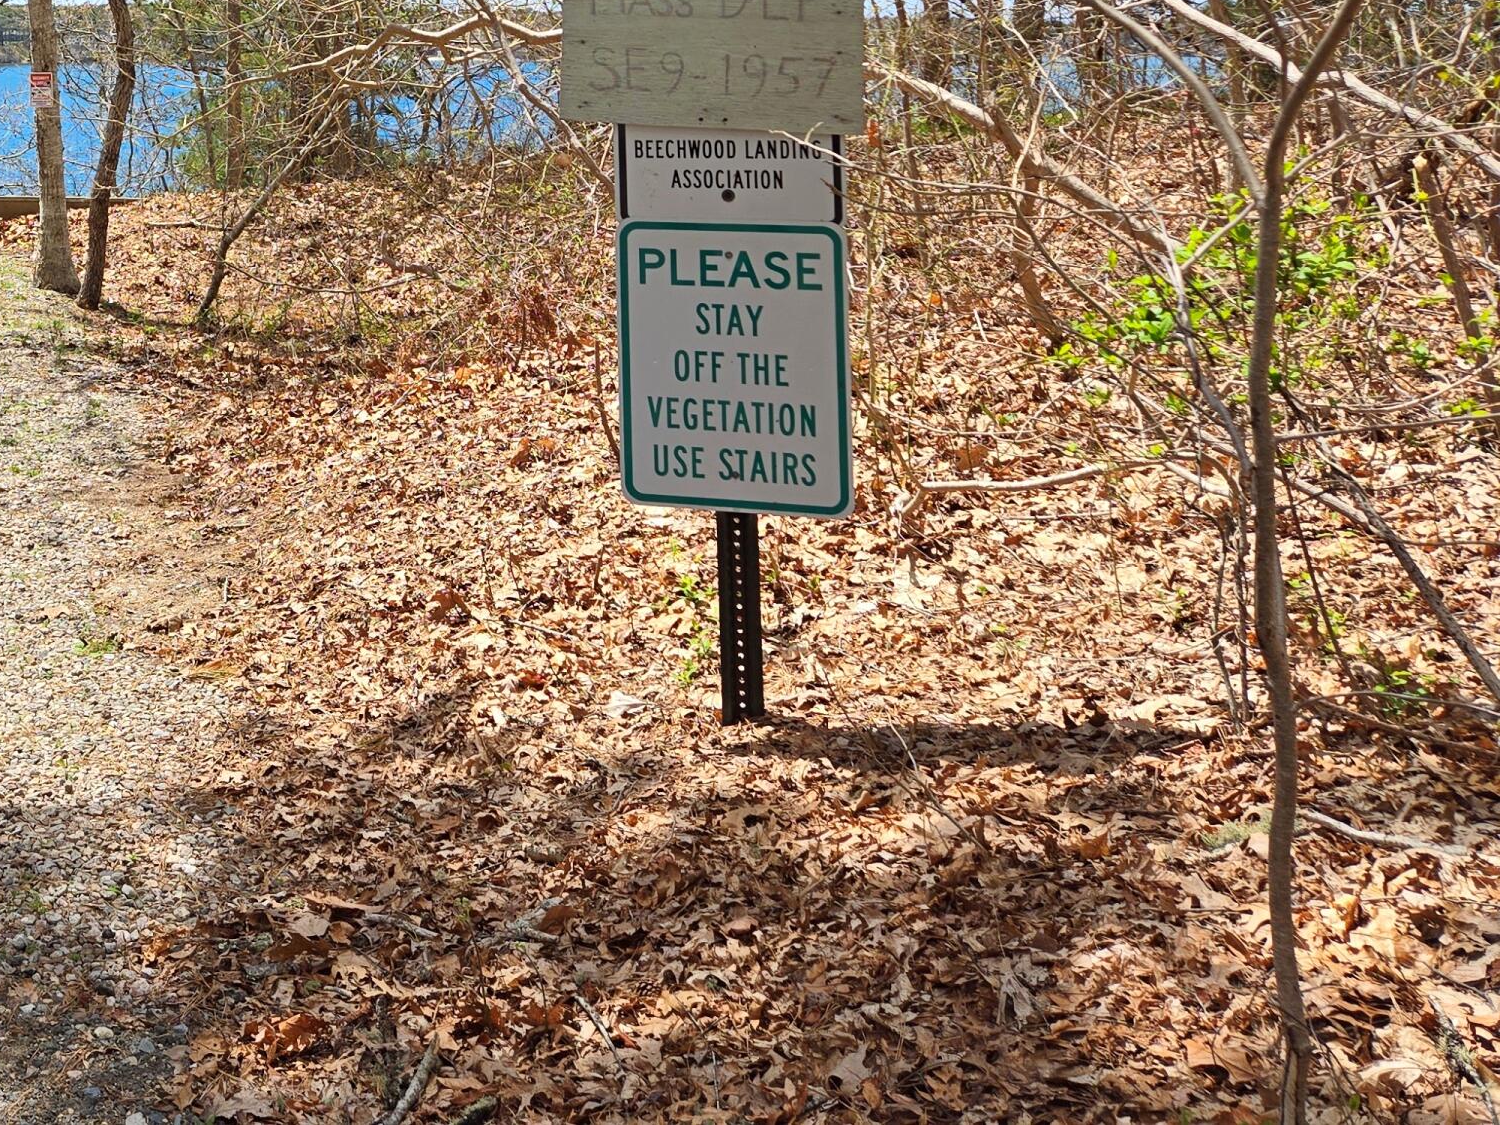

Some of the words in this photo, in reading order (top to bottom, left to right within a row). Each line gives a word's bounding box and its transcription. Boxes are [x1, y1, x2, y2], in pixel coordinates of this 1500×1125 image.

[634, 139, 736, 160] BEECHWOOD
[745, 139, 822, 160] LANDING
[671, 169, 784, 190] ASSOCIATION
[638, 247, 823, 291] PLEASE
[695, 303, 764, 337] STAY
[674, 349, 725, 383] OFF
[737, 352, 789, 387] THE
[647, 396, 817, 437] VEGETATION
[653, 444, 705, 479] USE
[718, 448, 817, 487] STAIRS
